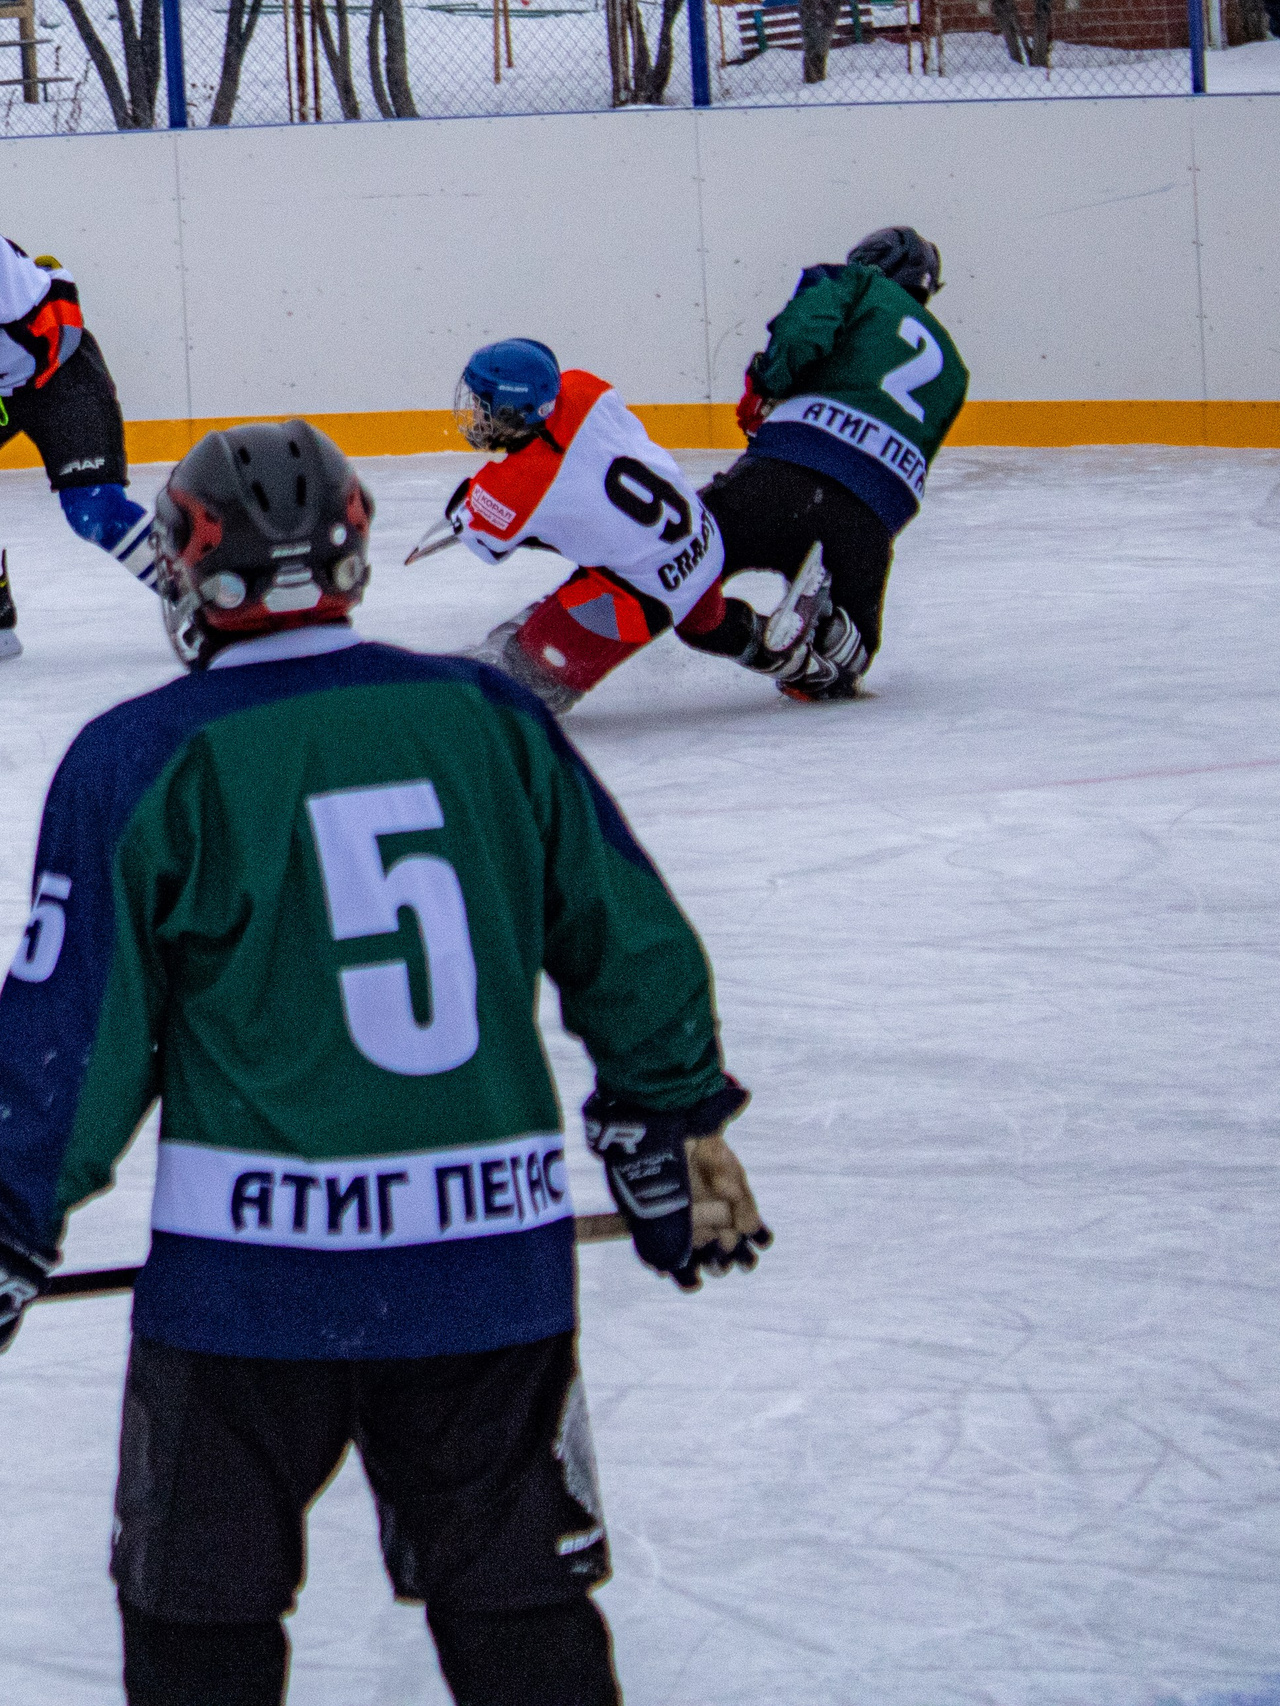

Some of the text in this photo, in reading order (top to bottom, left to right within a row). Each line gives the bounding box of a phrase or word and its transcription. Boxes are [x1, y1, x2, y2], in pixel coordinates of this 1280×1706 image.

[879, 315, 945, 424] 2
[802, 402, 880, 445] АТИГ
[481, 495, 512, 519] КОРАЛ
[604, 455, 693, 545] 9
[9, 870, 72, 983] 5
[308, 778, 480, 1077] 5
[230, 1170, 410, 1242] АТИГ
